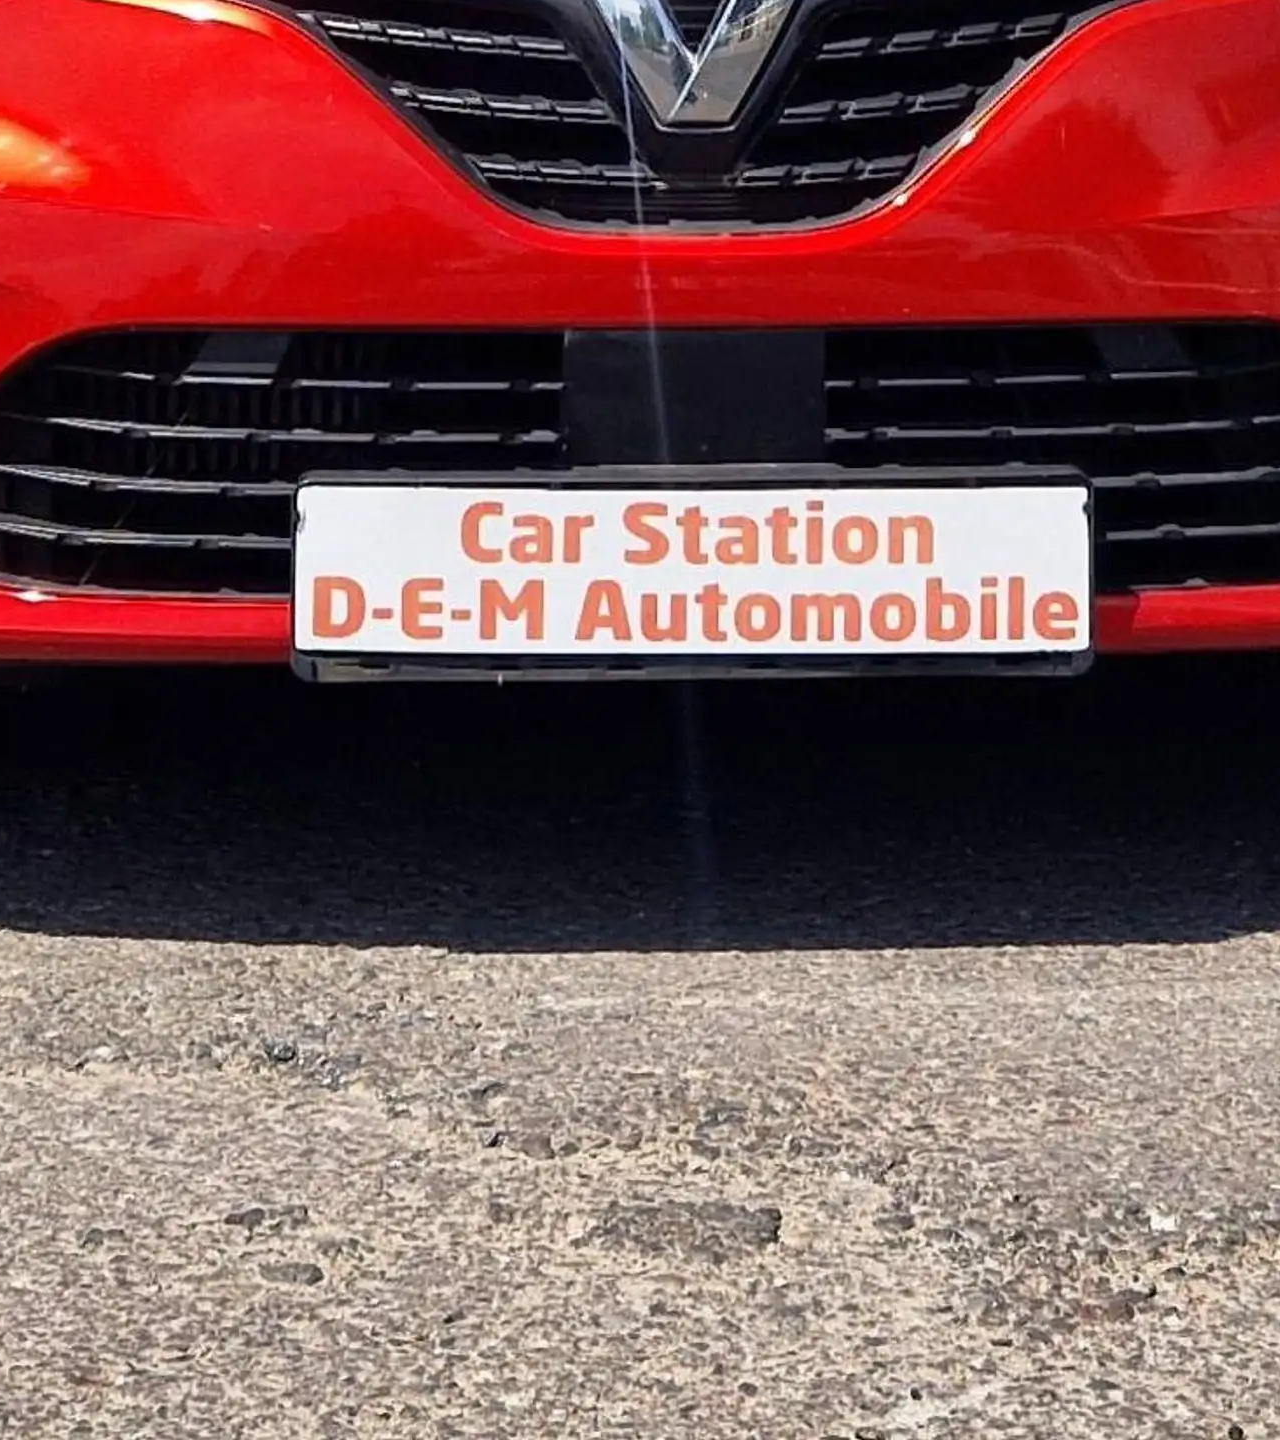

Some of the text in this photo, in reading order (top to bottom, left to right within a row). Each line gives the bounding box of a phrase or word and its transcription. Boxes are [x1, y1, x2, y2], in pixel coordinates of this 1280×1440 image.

[460, 500, 934, 566] Car Station
[311, 575, 1080, 643] D-E-M Automobile
